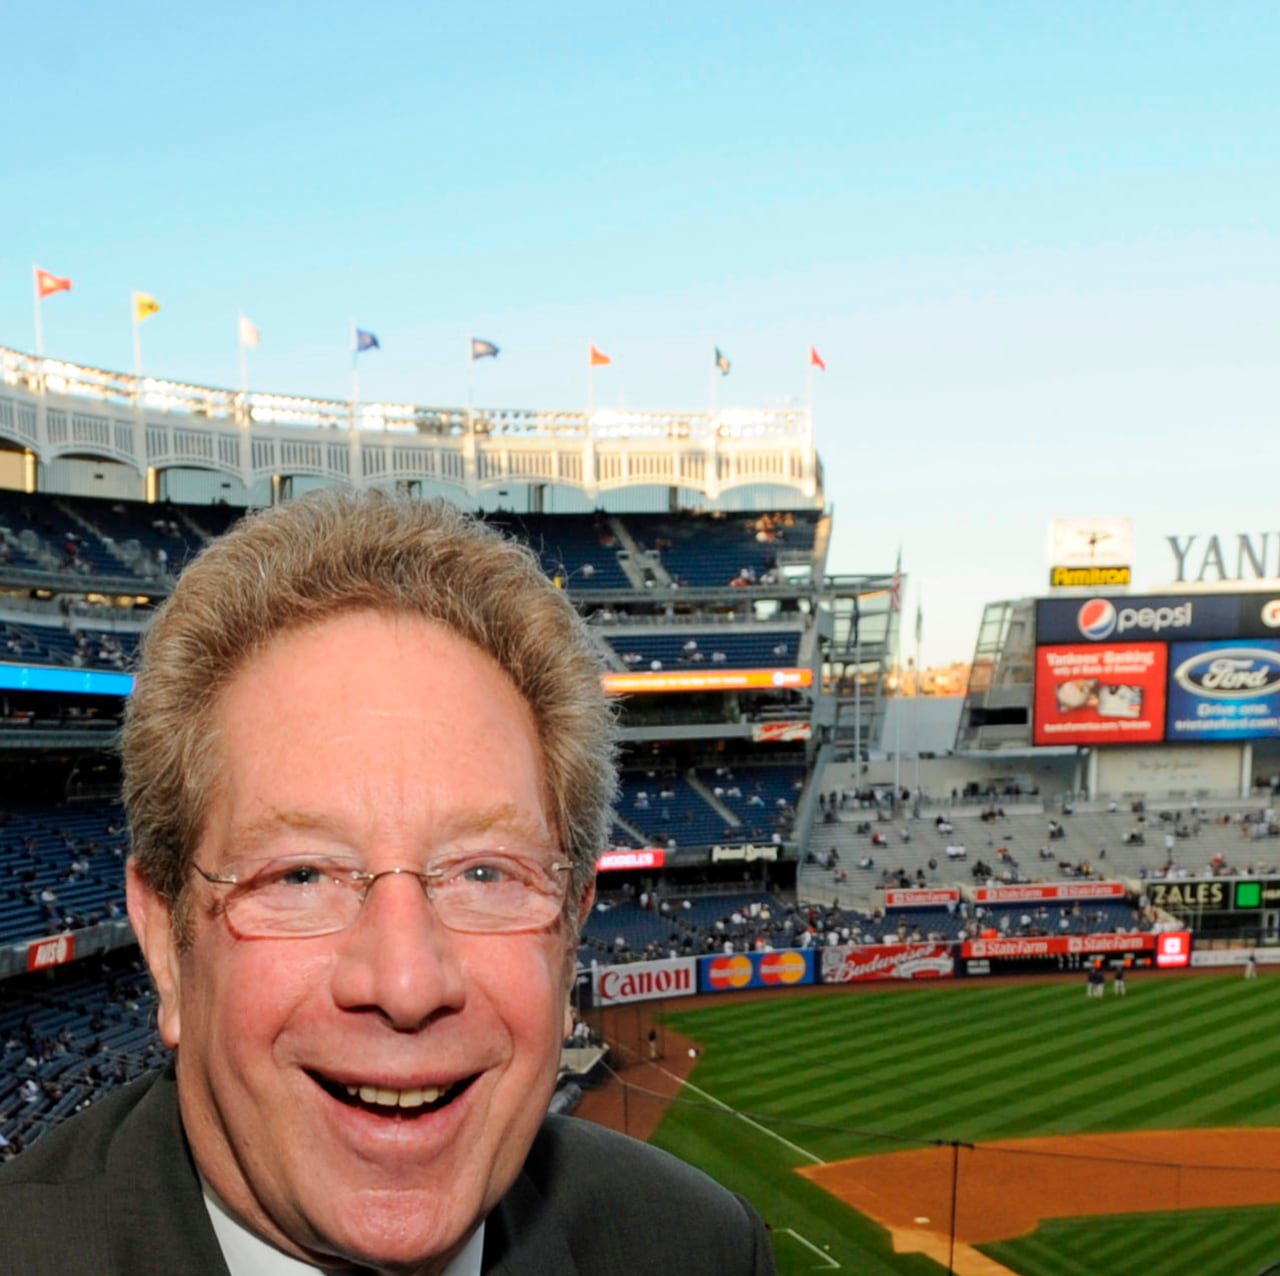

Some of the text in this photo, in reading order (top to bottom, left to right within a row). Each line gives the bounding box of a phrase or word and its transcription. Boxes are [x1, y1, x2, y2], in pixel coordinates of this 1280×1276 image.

[1053, 567, 1130, 586] Armitron
[1117, 602, 1192, 633] pepsi
[1202, 658, 1269, 690] Ford
[1154, 883, 1223, 904] ZALES
[836, 943, 935, 982] Budweiser
[599, 967, 691, 1000] Canon
